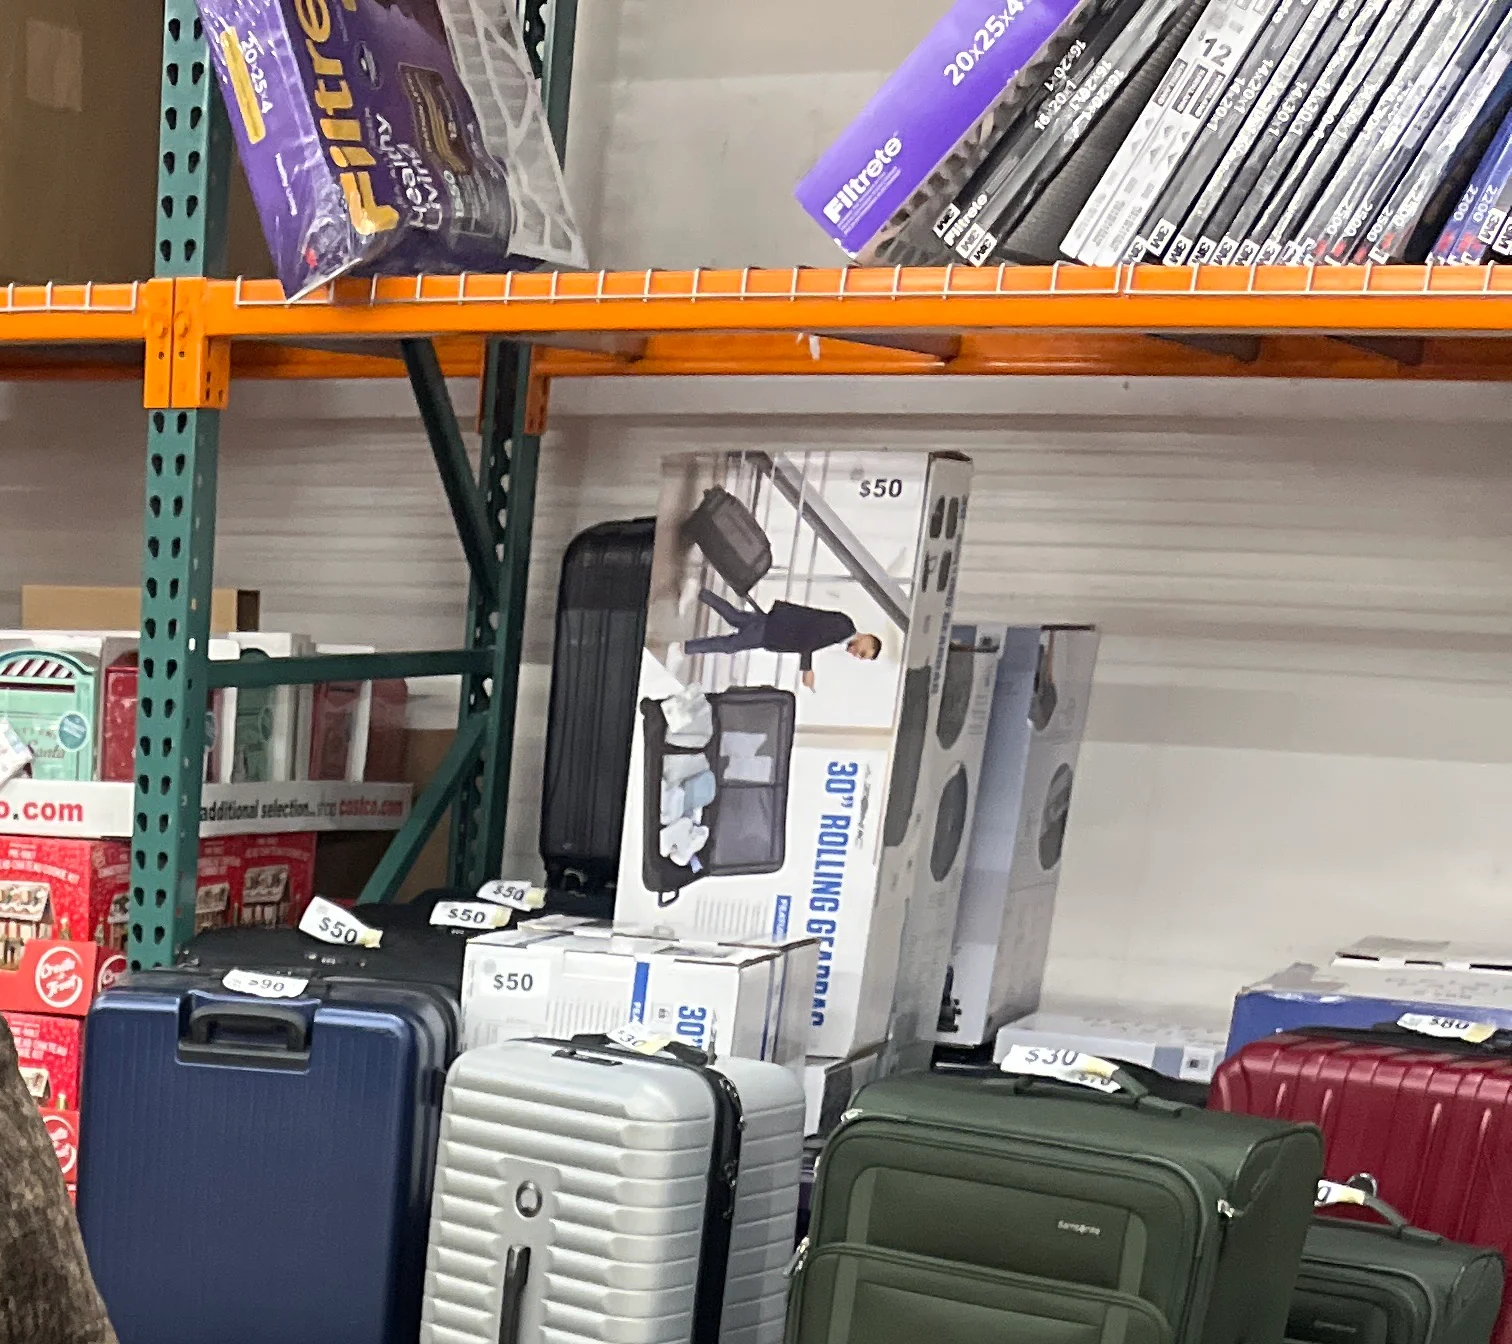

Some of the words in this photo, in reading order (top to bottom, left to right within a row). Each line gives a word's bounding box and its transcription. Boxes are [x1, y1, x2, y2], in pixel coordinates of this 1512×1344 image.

[823, 137, 903, 224] Filtrete
[1150, 224, 1170, 249] 3M
[859, 478, 904, 499] $50
[200, 799, 260, 822] additional
[808, 813, 852, 914] ROLLING
[493, 883, 526, 902] $50
[448, 907, 487, 925] $50
[318, 915, 359, 944] $50
[493, 973, 535, 993] $50
[1024, 1048, 1080, 1067] $30
